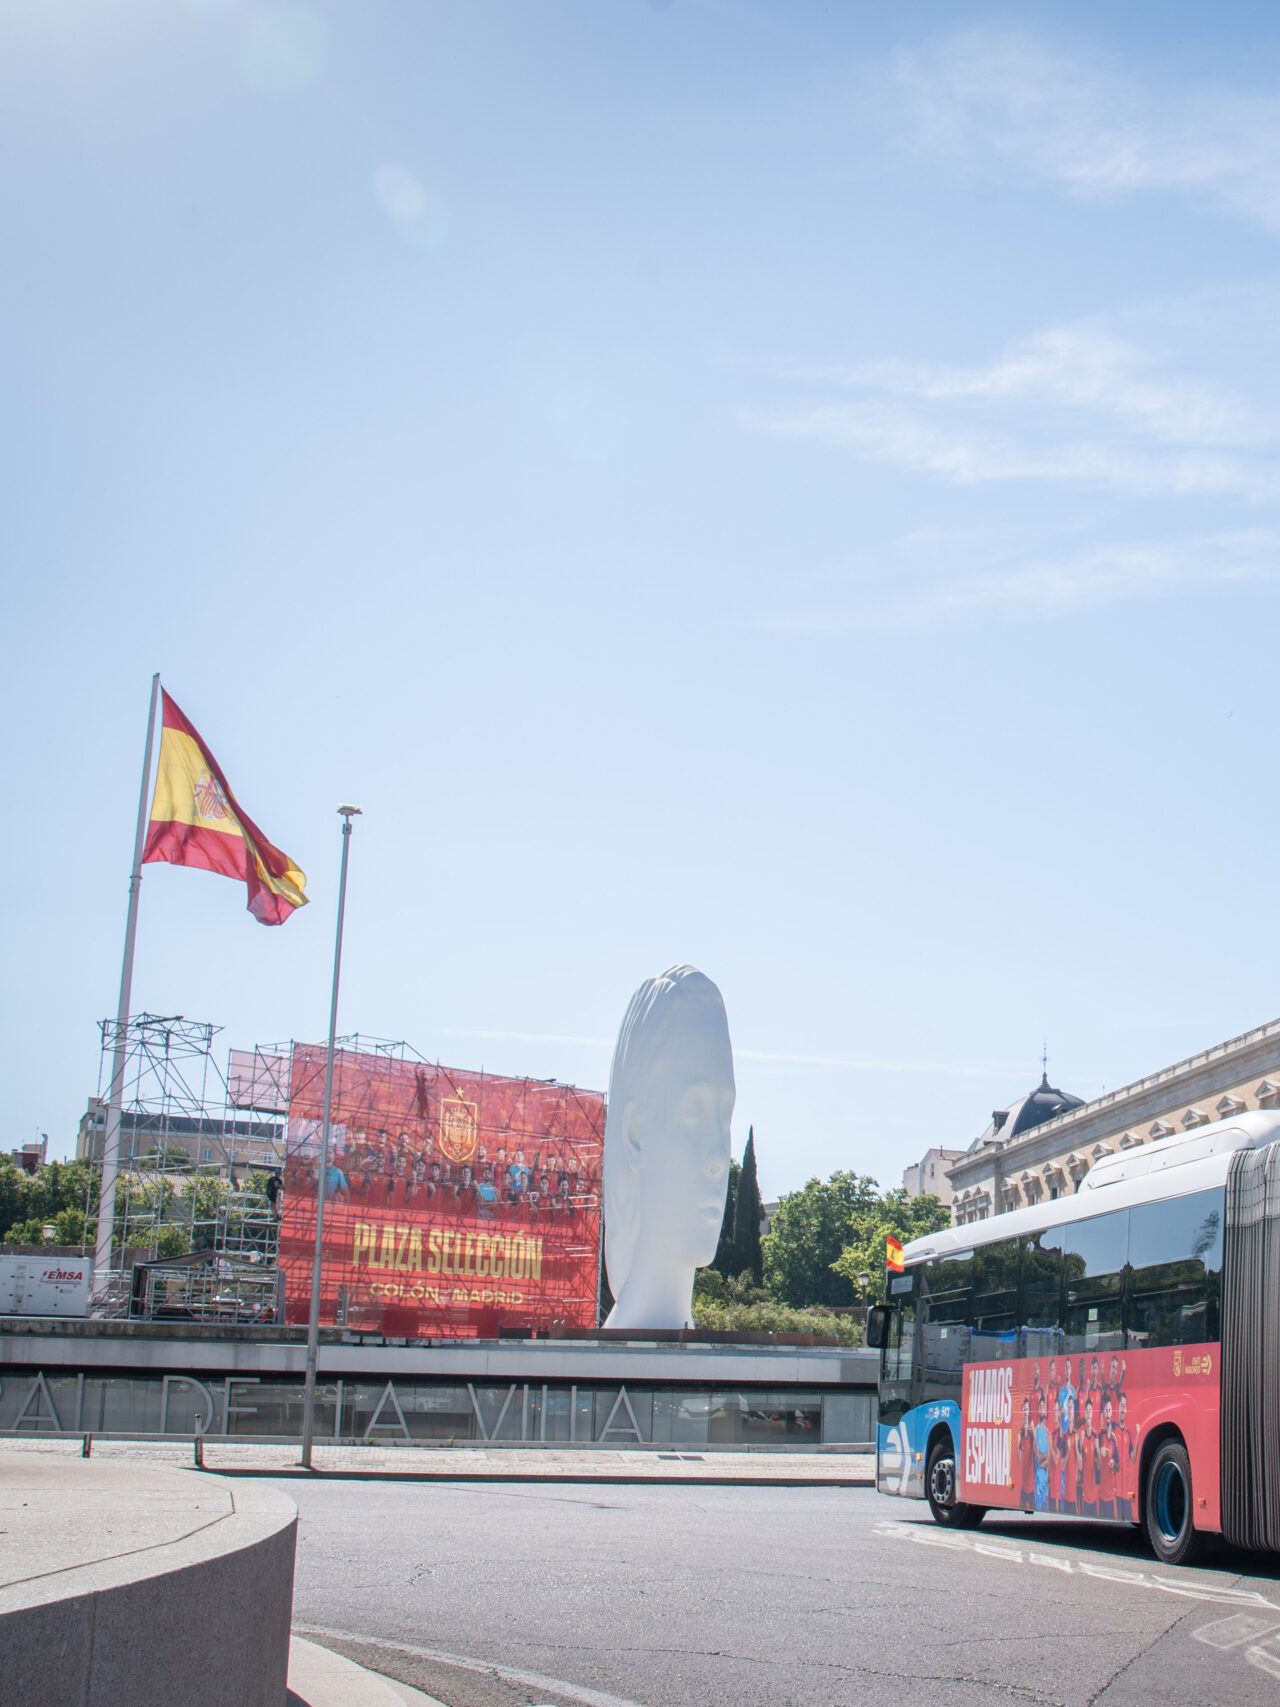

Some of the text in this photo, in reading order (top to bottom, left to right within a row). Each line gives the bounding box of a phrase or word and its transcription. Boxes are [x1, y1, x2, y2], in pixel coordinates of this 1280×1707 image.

[352, 1222, 543, 1280] PLAZA SELECCIÓN
[47, 1270, 83, 1280] EMSA
[370, 1280, 524, 1304] COLÓN MADRID
[159, 1375, 260, 1435] DE
